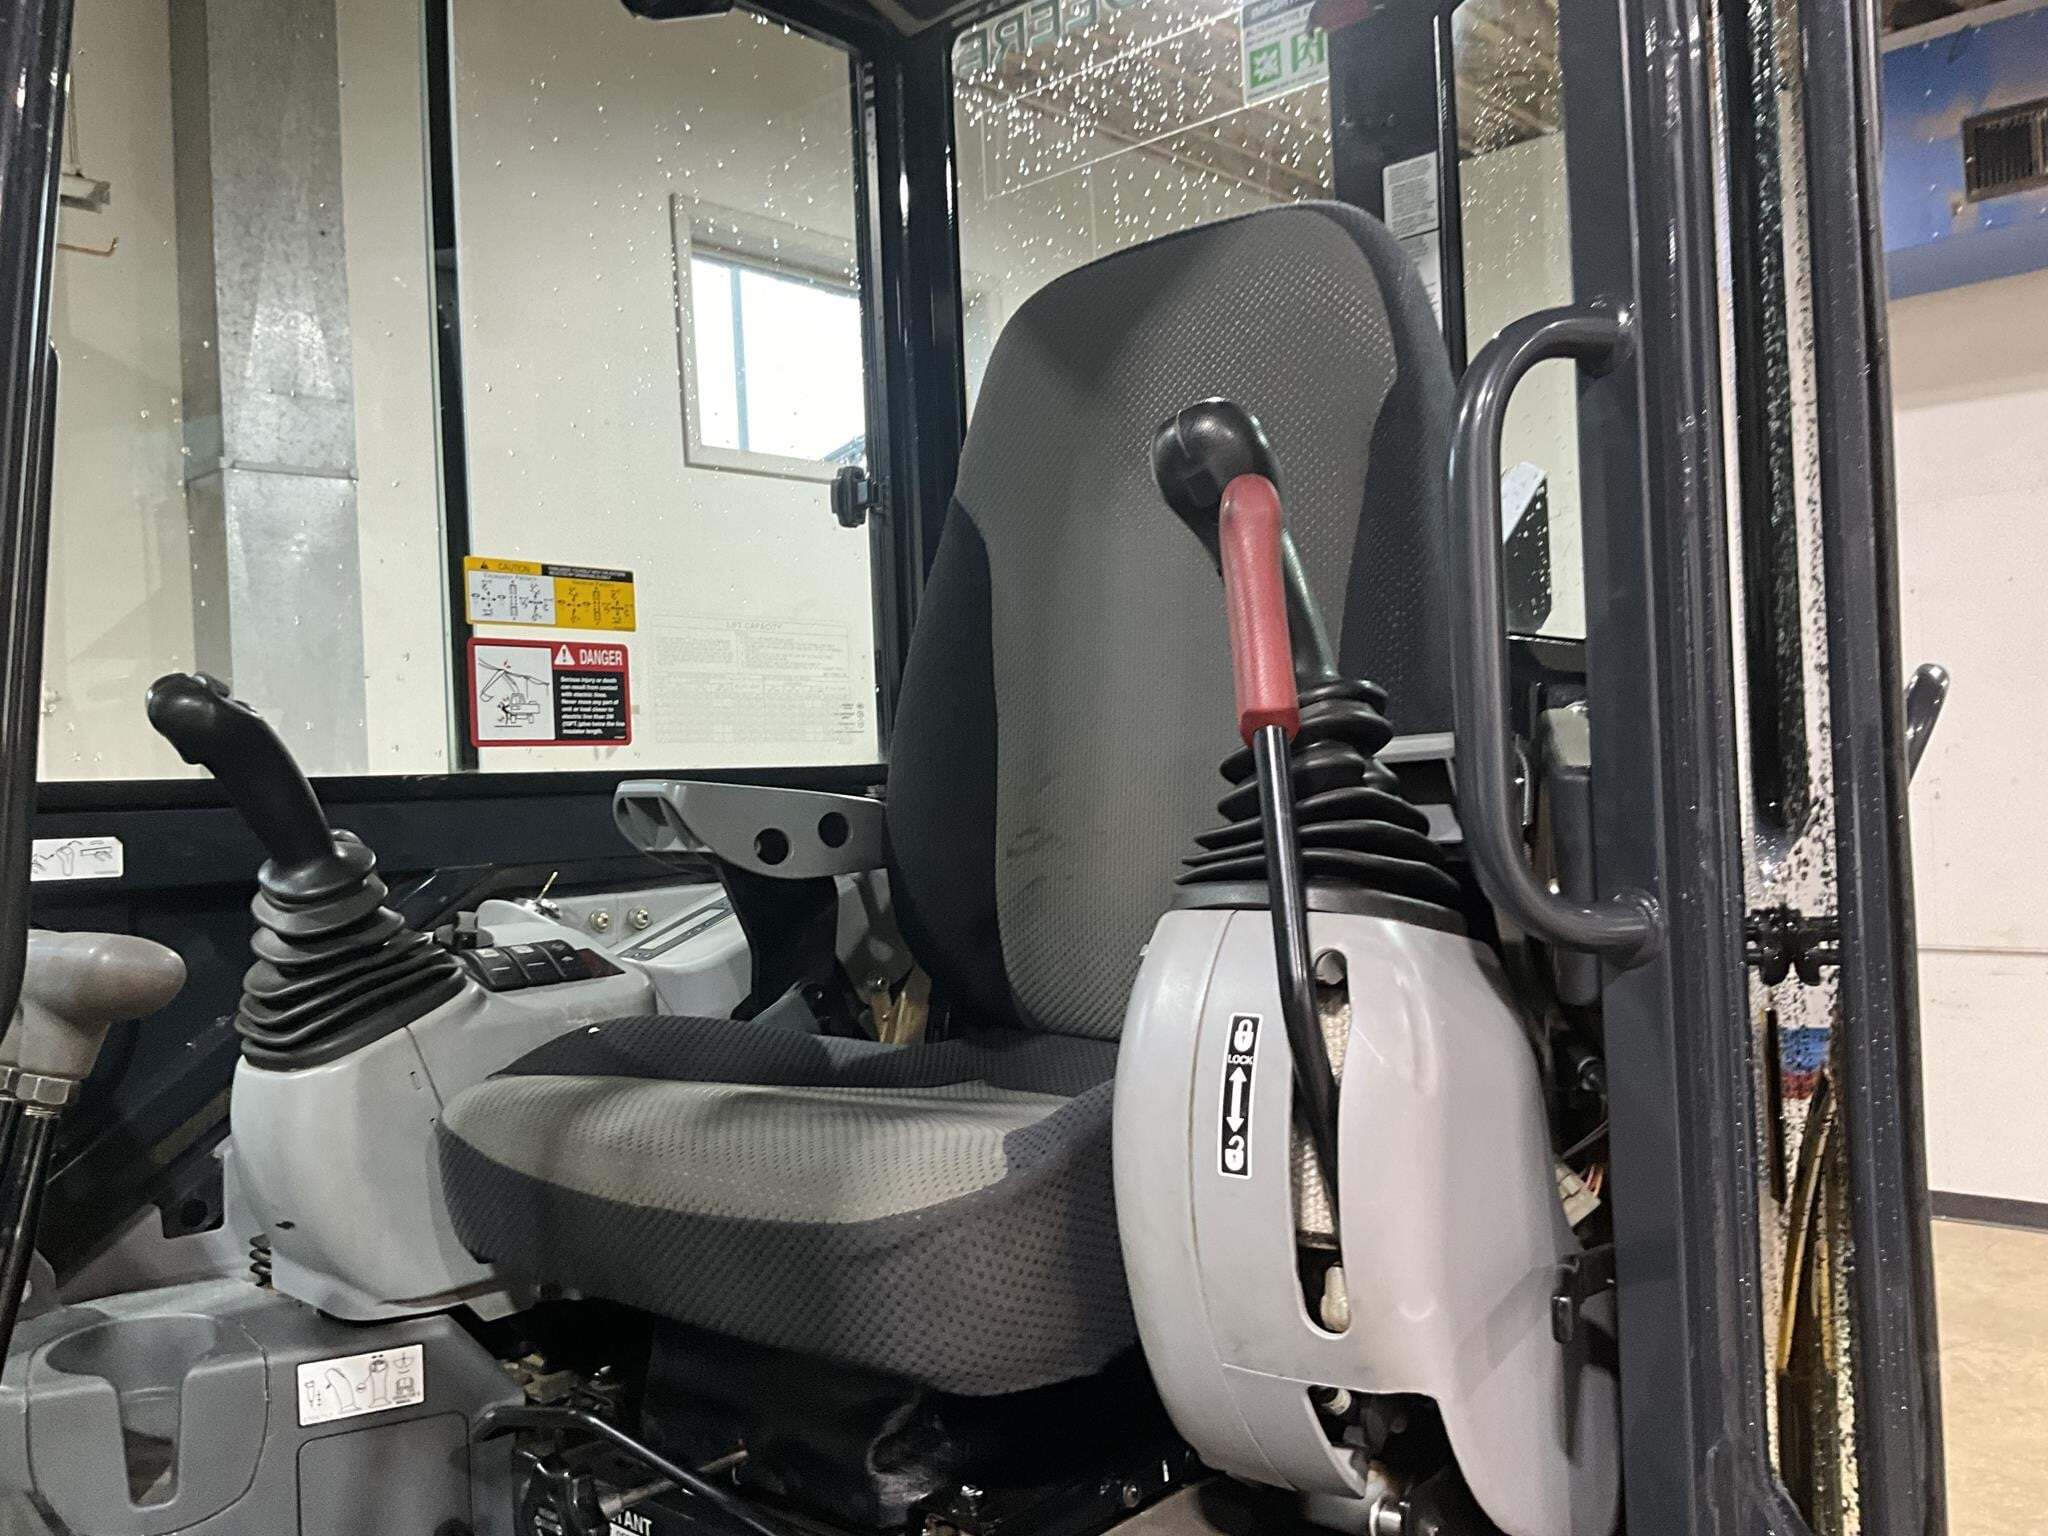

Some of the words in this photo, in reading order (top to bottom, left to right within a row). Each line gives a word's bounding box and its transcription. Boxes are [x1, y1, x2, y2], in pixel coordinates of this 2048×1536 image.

[498, 562, 530, 573] CAUTION
[579, 648, 623, 666] DANGER
[1228, 1054, 1254, 1065] LOCK
